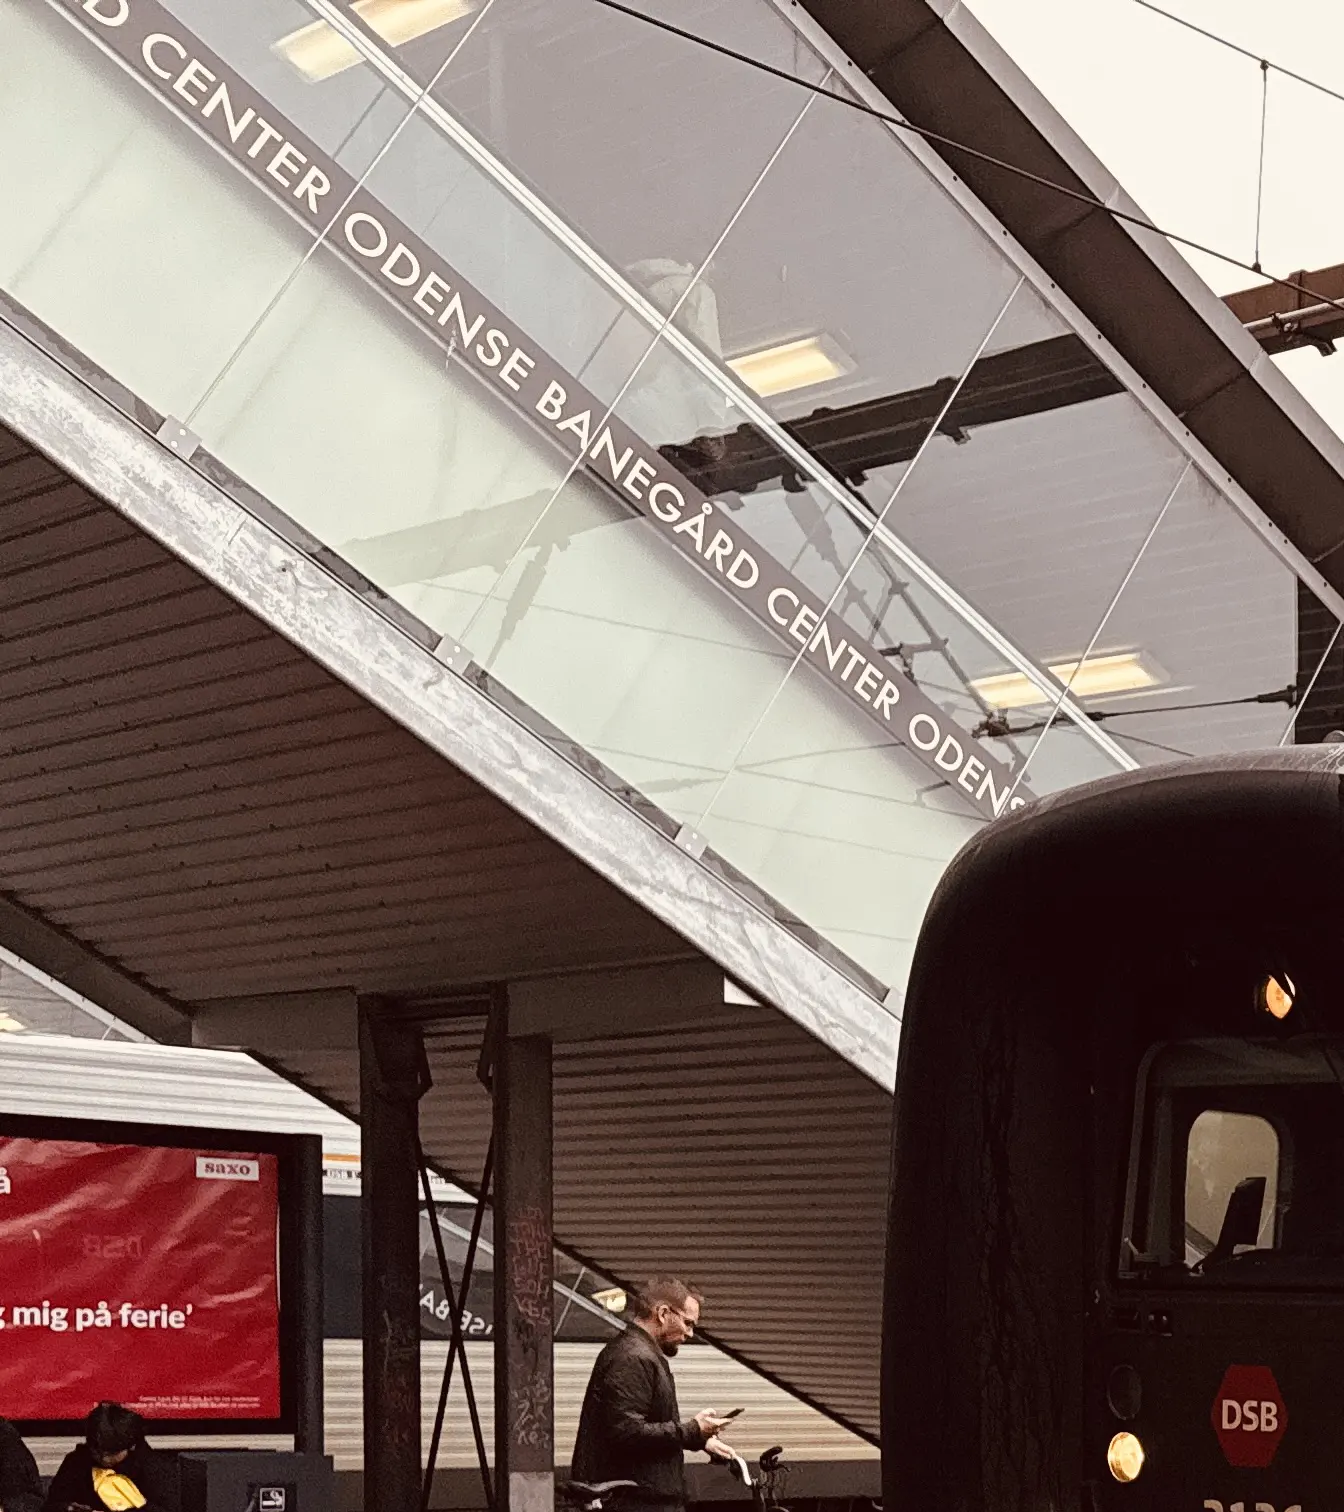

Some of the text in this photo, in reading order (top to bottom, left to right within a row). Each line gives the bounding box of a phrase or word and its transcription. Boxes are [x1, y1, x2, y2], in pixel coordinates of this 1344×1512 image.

[141, 33, 332, 214] CENTER
[344, 212, 536, 392] ODENSE
[535, 380, 760, 589] BANEGÅRD
[767, 587, 900, 720] CENTER
[204, 1161, 251, 1176] saxo
[13, 1300, 68, 1331] mig
[76, 1301, 112, 1331] på
[1221, 1399, 1279, 1433] DSB
